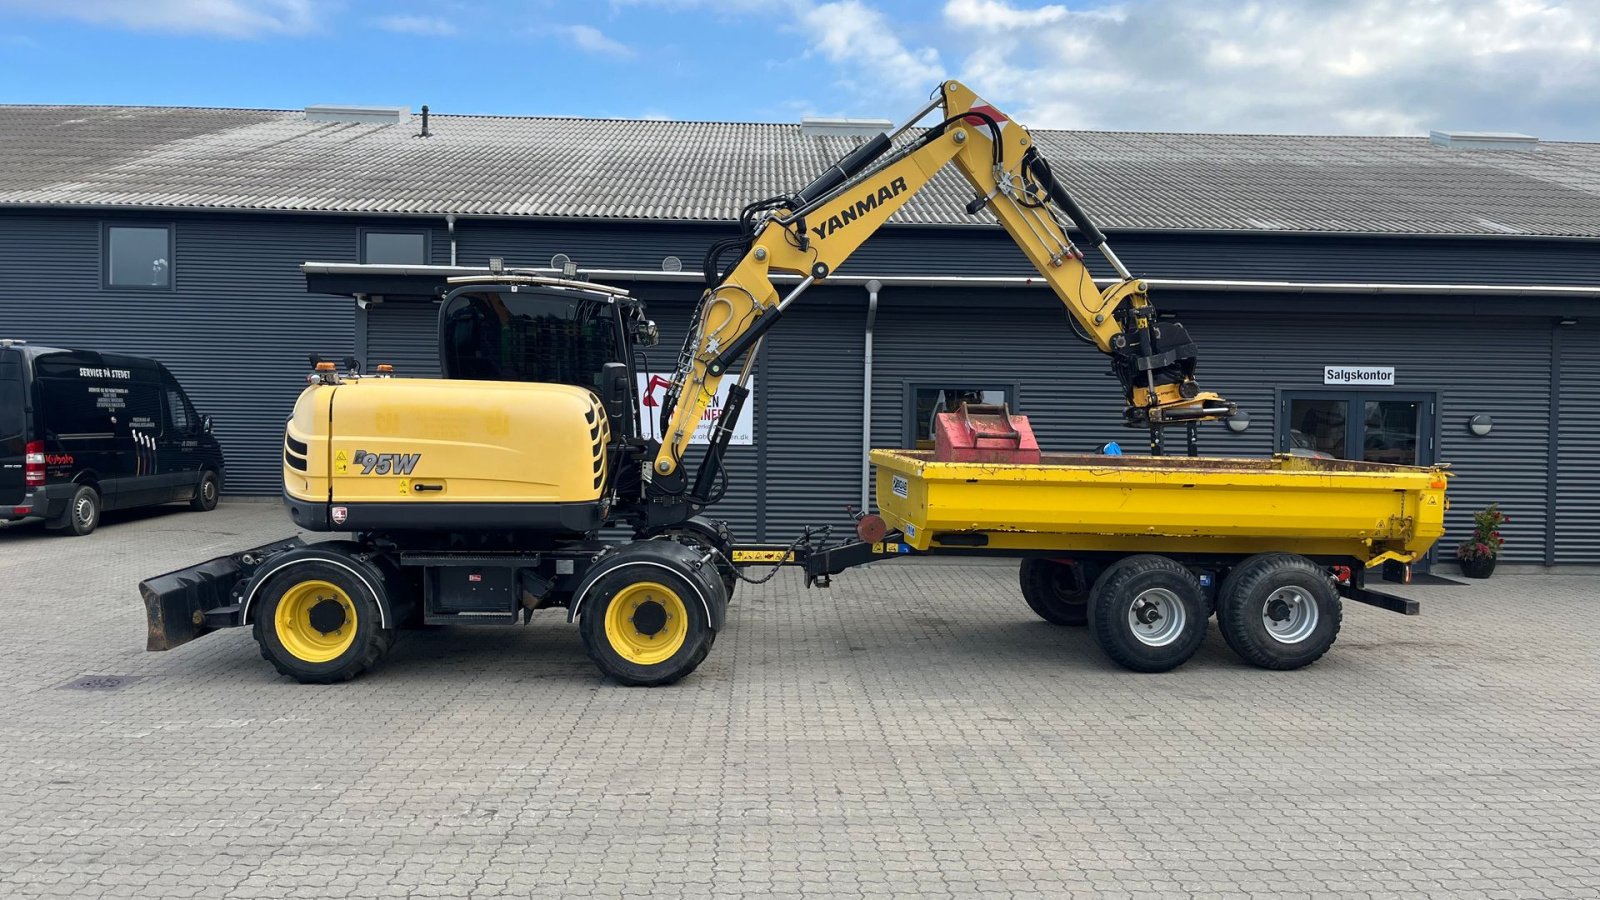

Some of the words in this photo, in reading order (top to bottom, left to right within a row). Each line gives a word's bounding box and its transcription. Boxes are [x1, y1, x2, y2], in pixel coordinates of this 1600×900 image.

[811, 176, 908, 240] YANMAR
[79, 367, 103, 378] SERVICE
[112, 369, 131, 379] STEDET
[1327, 369, 1392, 382] Salgskontor
[45, 454, 74, 465] Kubota
